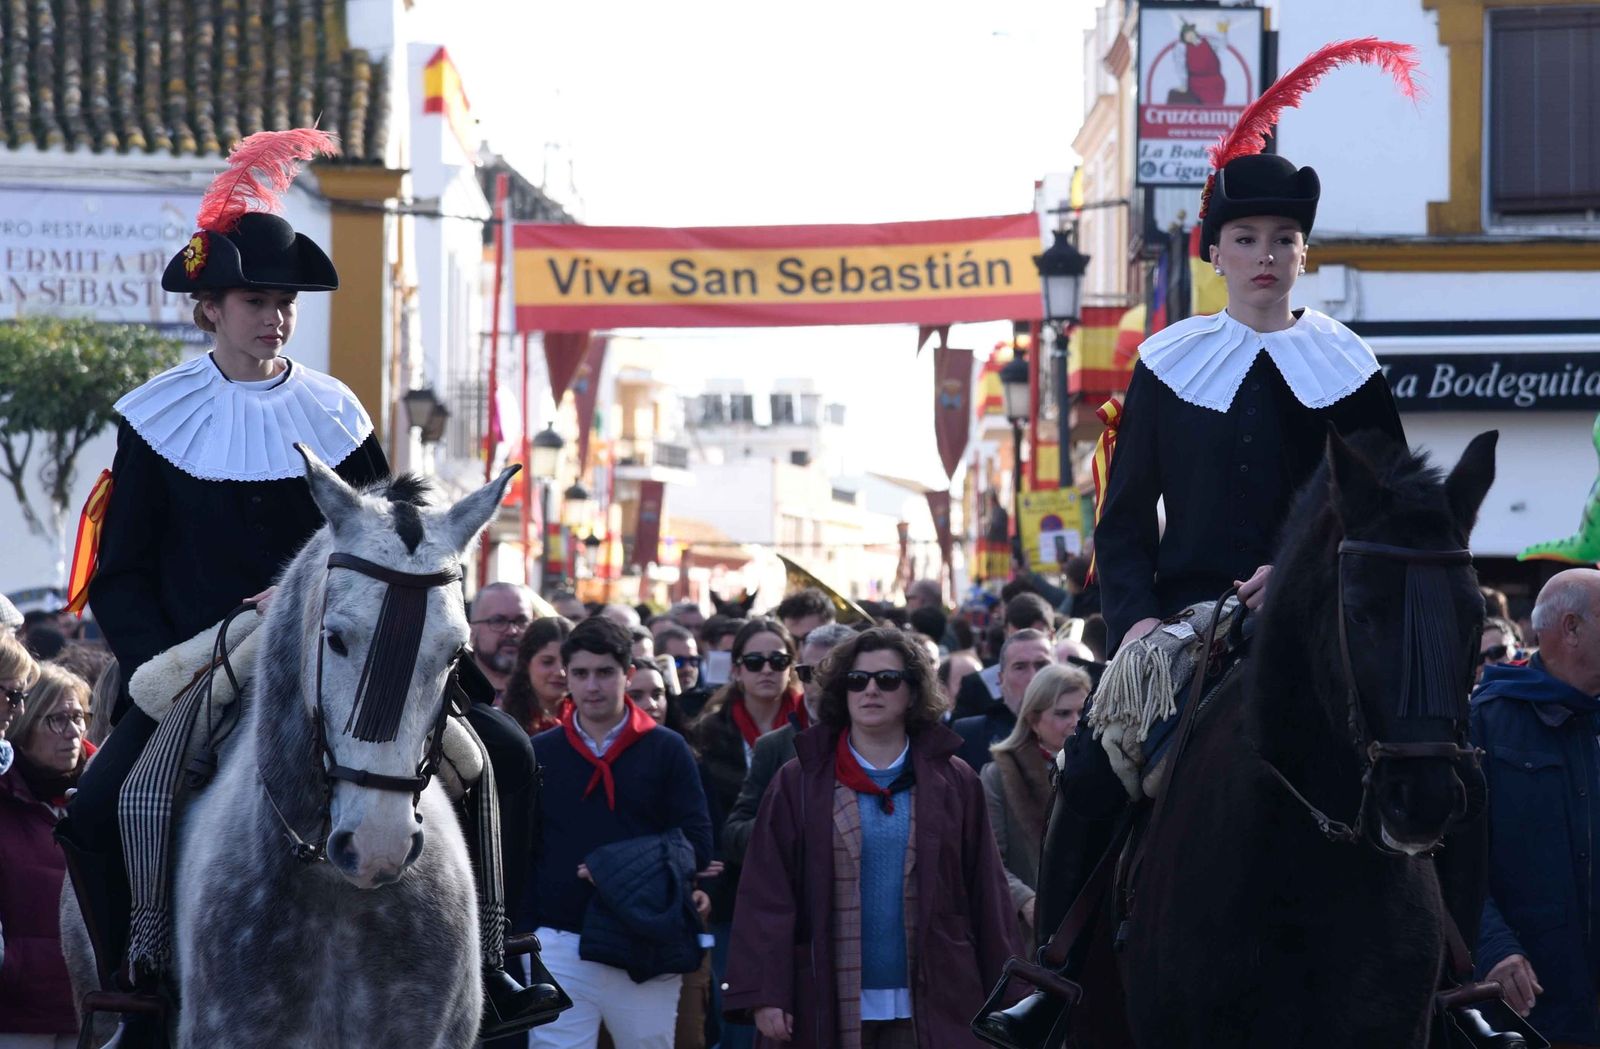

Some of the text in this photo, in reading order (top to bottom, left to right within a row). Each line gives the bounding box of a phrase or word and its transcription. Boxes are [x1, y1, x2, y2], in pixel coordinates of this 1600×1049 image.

[1145, 108, 1240, 129] Cruzcamp
[1141, 144, 1163, 158] La
[1160, 160, 1214, 181] Cigar
[6, 247, 126, 273] ERMITA
[548, 249, 1012, 296] Viva San Sebastián
[39, 277, 192, 307] SEBASTI
[1428, 361, 1600, 408] Bodeguita
